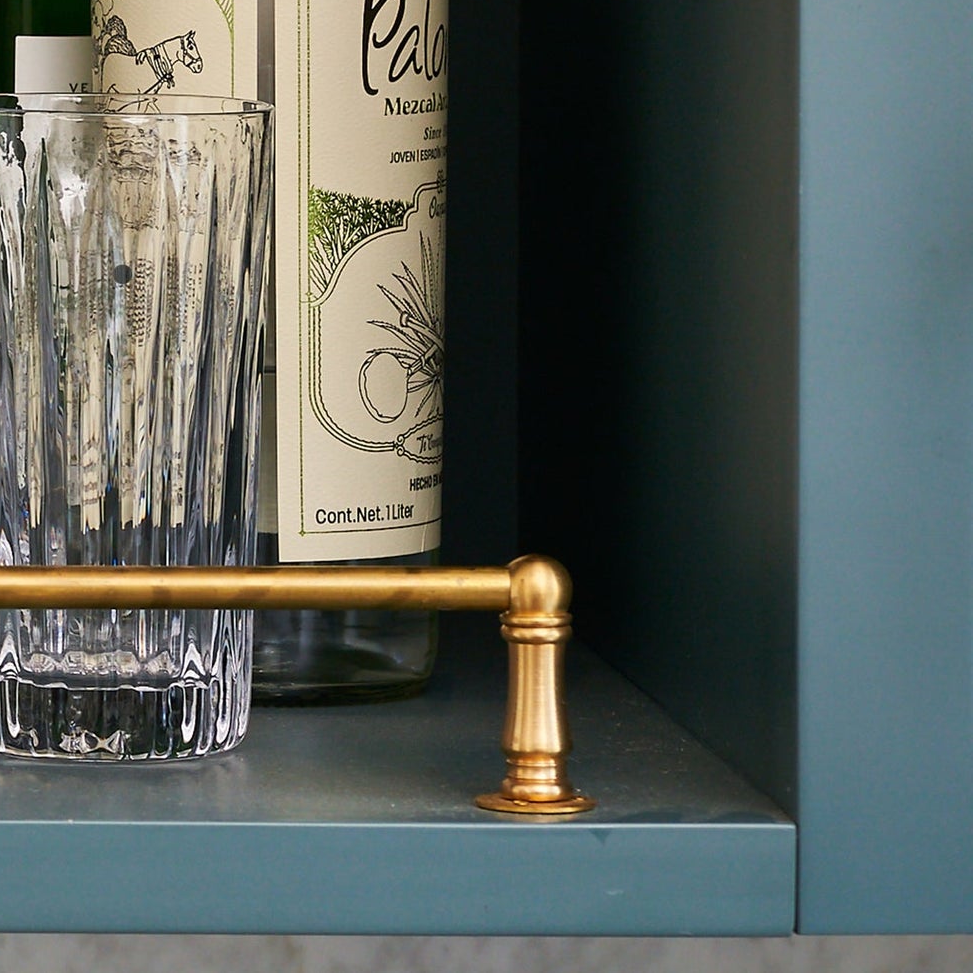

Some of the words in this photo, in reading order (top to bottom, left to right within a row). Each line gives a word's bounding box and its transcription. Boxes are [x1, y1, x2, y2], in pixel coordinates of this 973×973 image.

[384, 92, 436, 116] Mezcal
[390, 151, 415, 163] JOVEN
[392, 504, 414, 520] Liter
